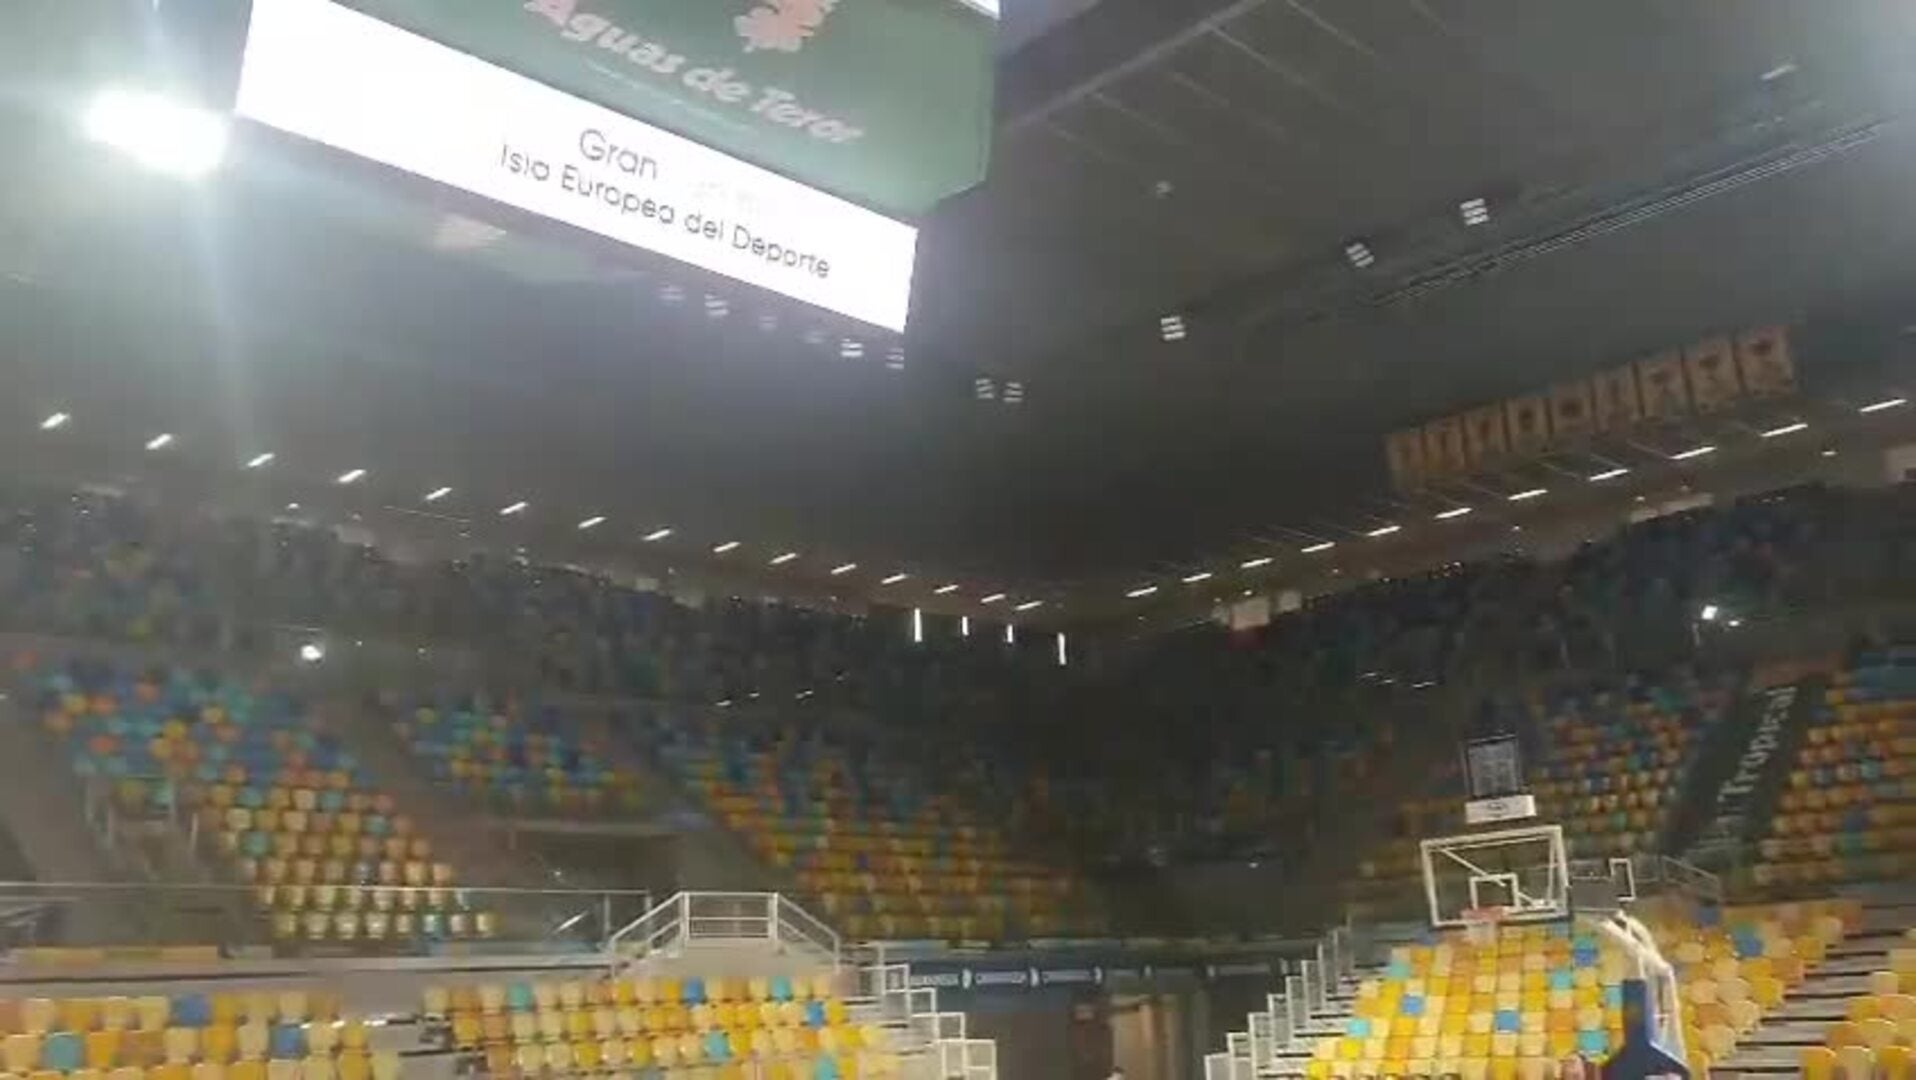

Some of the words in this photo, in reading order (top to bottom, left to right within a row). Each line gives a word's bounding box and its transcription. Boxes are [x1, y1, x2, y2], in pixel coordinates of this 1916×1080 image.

[523, 0, 686, 74] Aguas
[682, 65, 750, 103] de
[750, 86, 864, 143] Teror
[499, 143, 551, 182] Isla
[560, 163, 675, 225] Europea
[683, 208, 724, 241] del
[731, 223, 831, 279] Deporte
[578, 127, 658, 180] Gran
